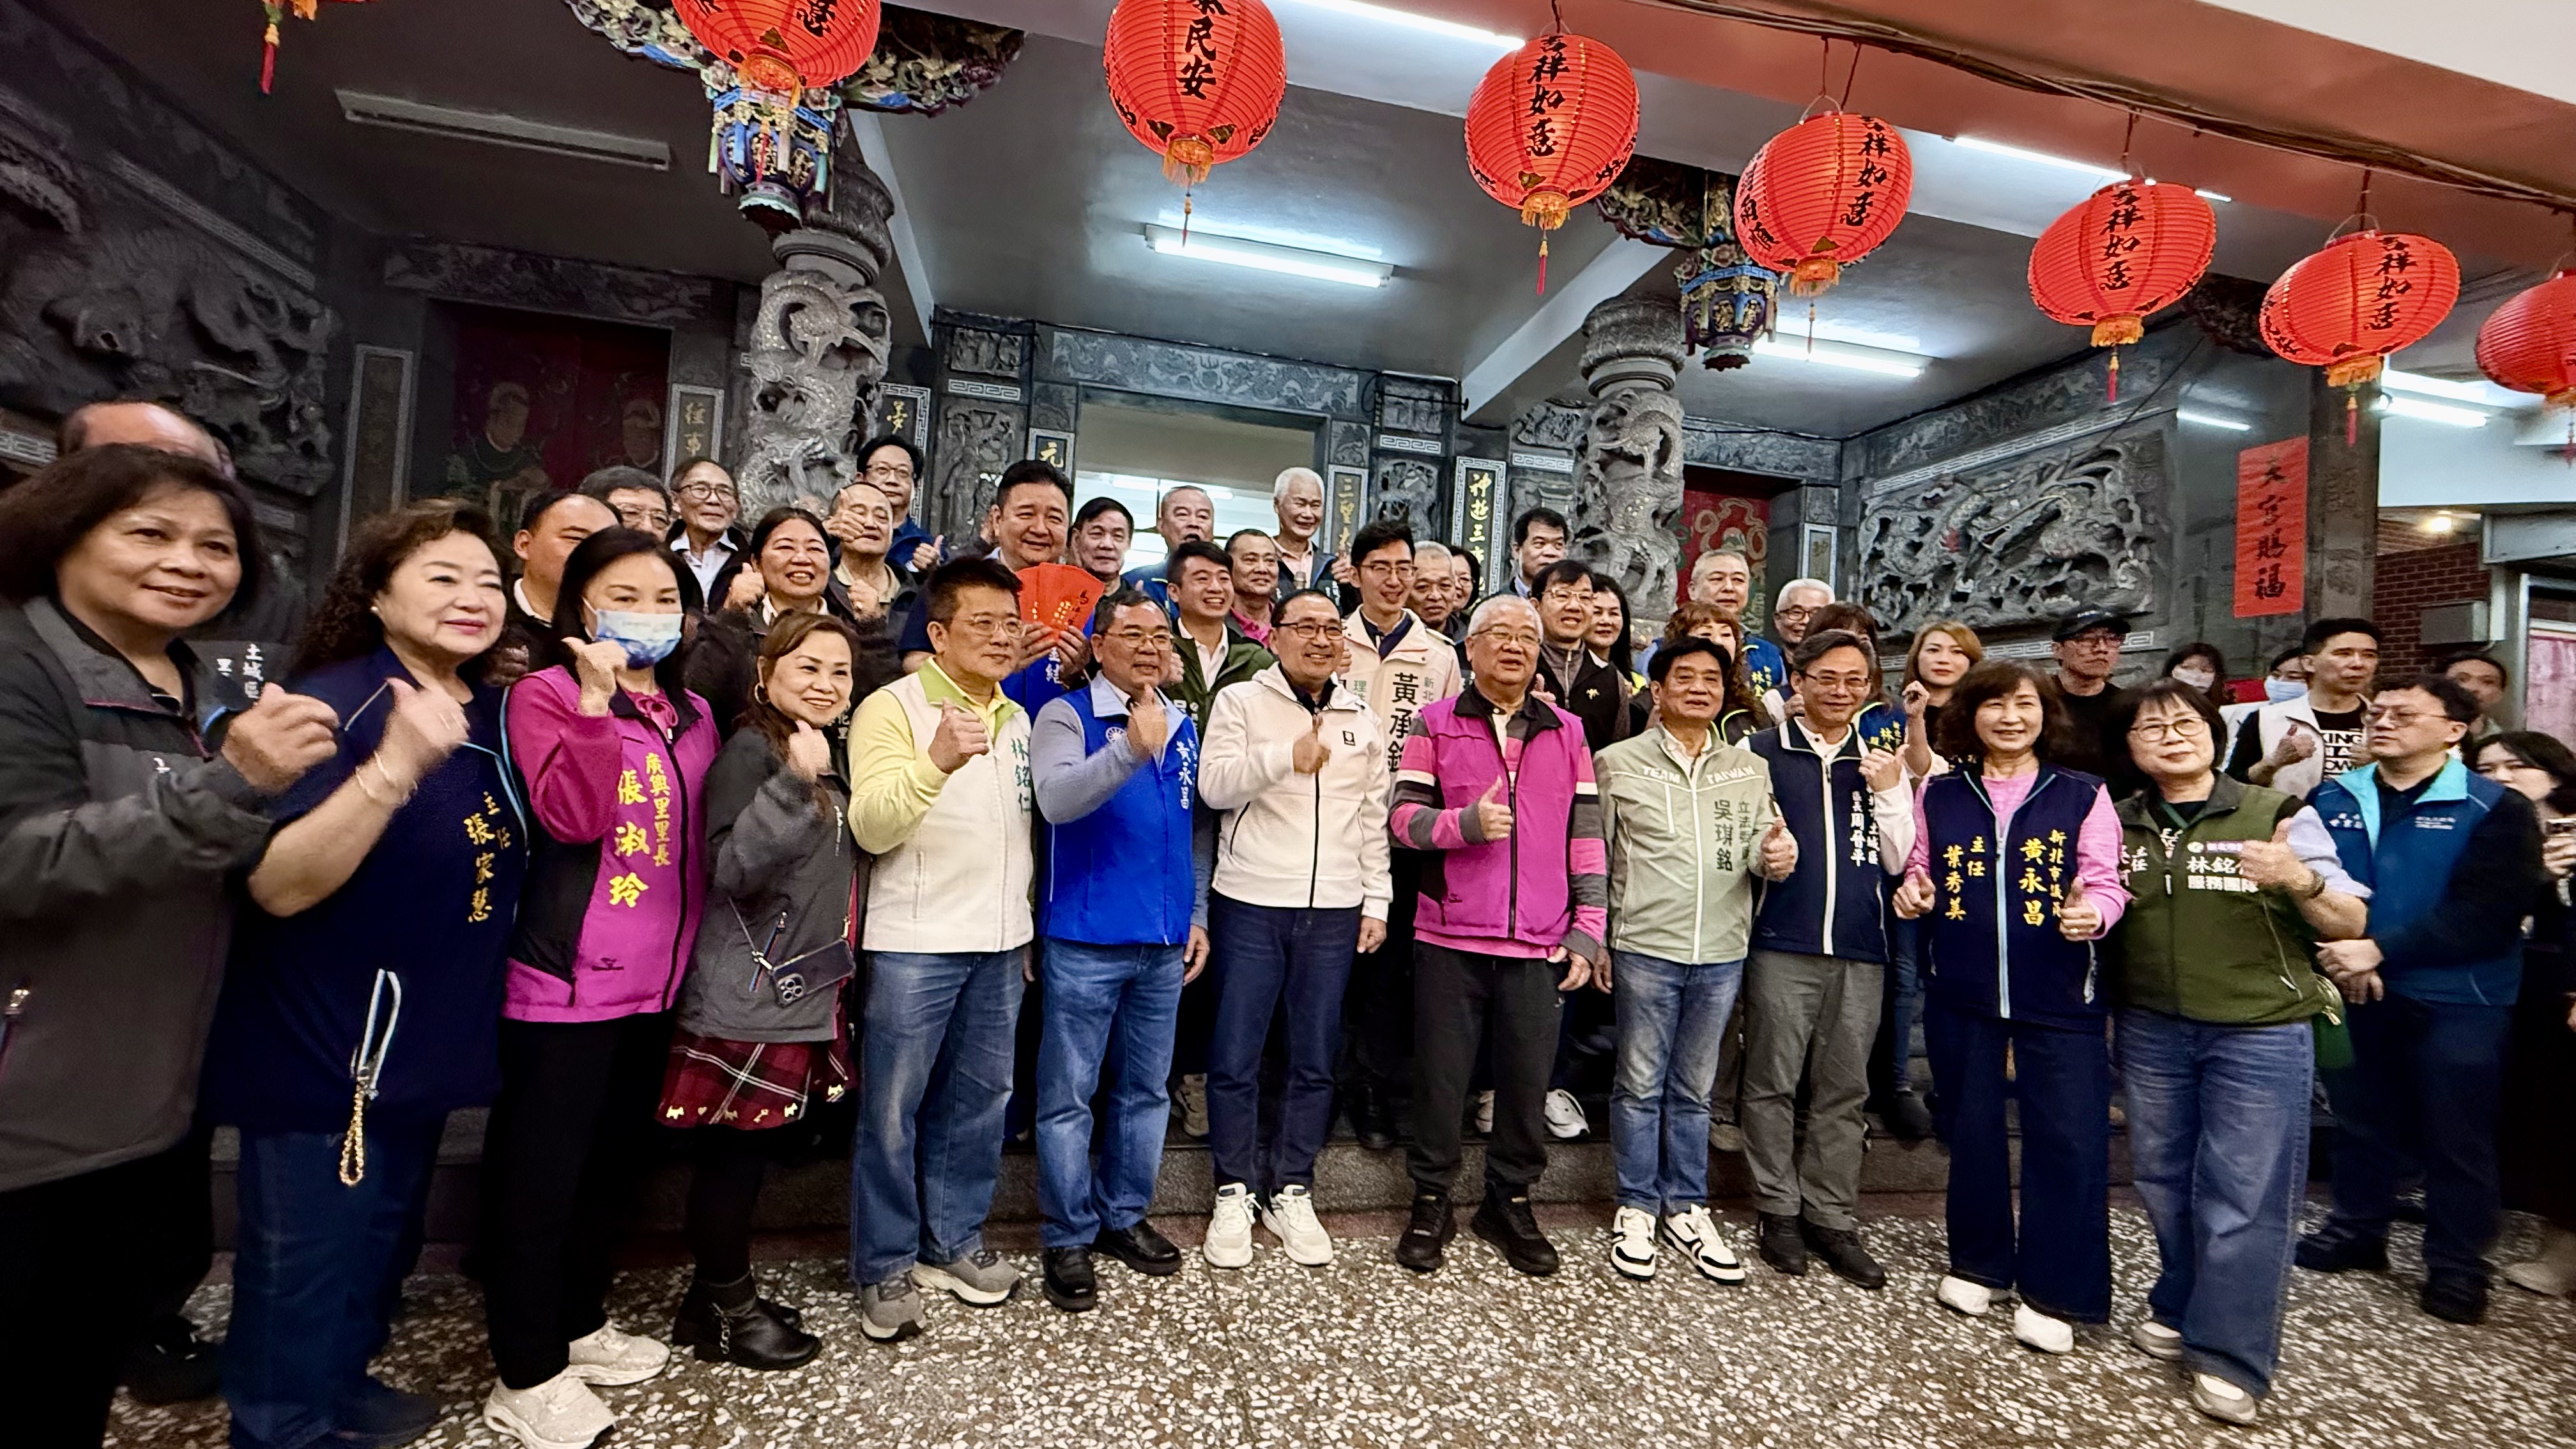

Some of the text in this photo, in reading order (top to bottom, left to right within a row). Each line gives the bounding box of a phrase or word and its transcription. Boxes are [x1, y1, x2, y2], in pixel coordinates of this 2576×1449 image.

[1526, 35, 1570, 157] 吉祥如意
[1840, 115, 1891, 226] 吉祥如意
[2099, 188, 2145, 291] 吉祥如意
[2364, 237, 2419, 330] 吉祥如意
[217, 658, 233, 677] 里
[243, 643, 264, 700] 土城區
[1422, 677, 1436, 708] 新北
[645, 752, 671, 868] 廣興里里長
[1011, 735, 1032, 815] 林銘仁
[1176, 740, 1193, 810] 黃永昌
[1642, 765, 1756, 785] TEAM TAIWAN
[463, 813, 496, 923] 張家慧
[609, 769, 650, 908] 張淑玲
[1713, 799, 1733, 871] 吳琪銘
[1968, 836, 1986, 877] 主任
[1943, 845, 1966, 921] 葉秀美
[2019, 838, 2048, 926] 黃永昌
